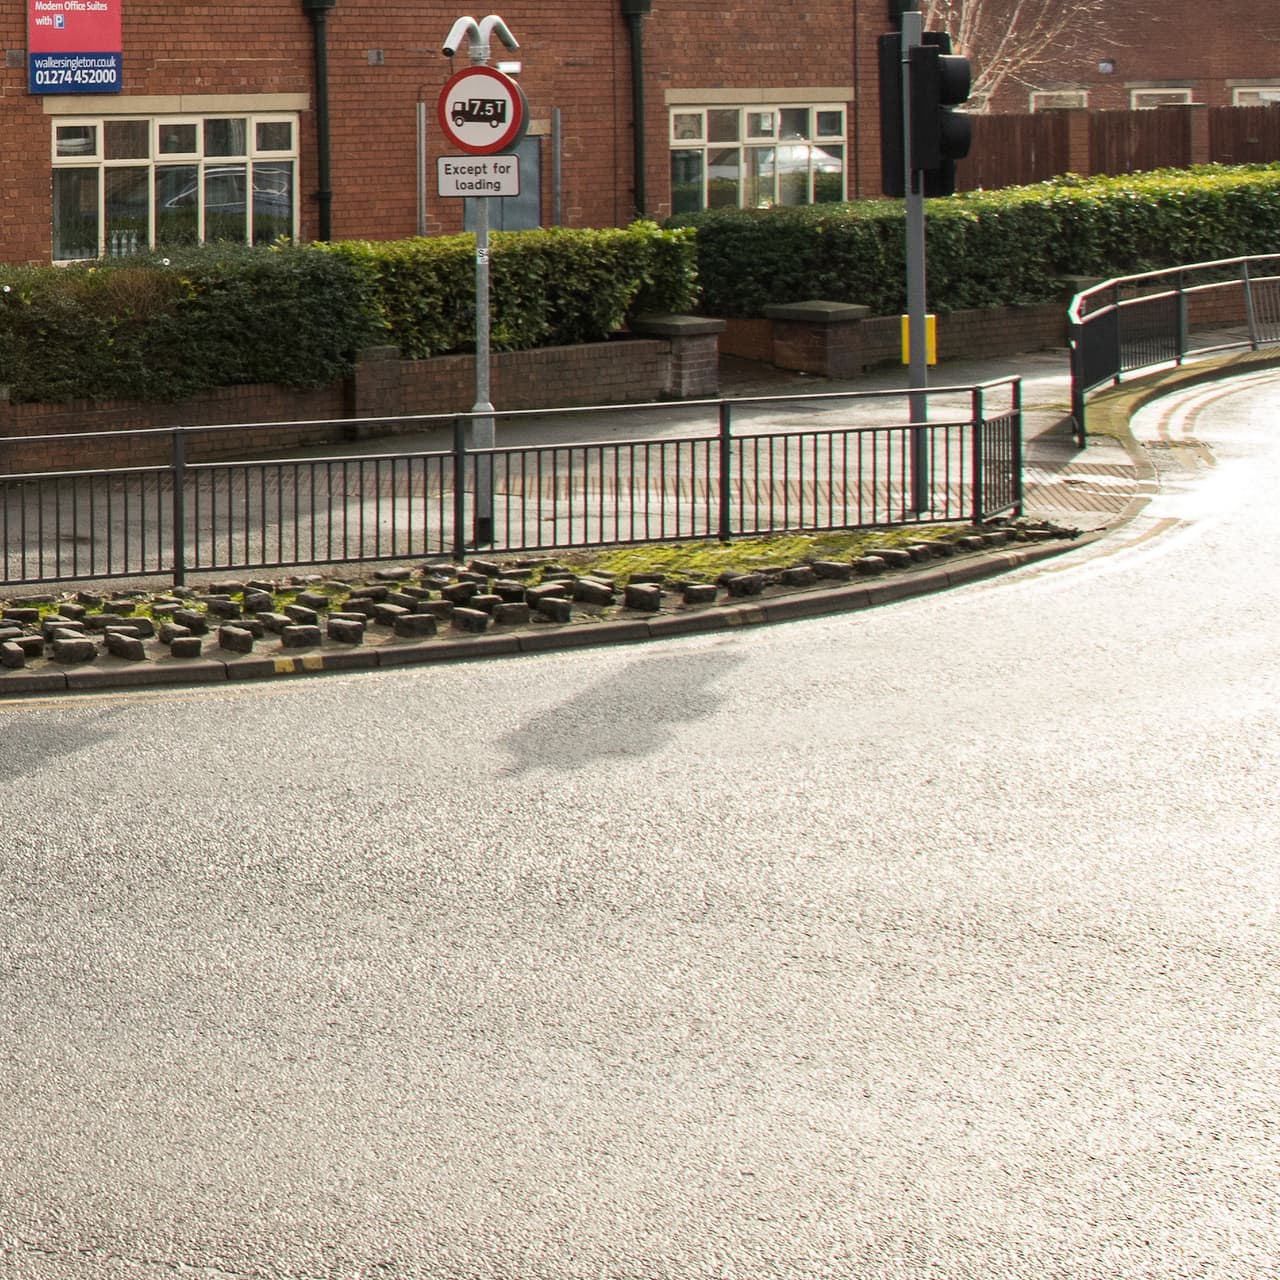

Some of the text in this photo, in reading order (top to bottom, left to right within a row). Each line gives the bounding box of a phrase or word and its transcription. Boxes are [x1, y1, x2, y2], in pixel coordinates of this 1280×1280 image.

[35, 0, 108, 11] Modern Office Suites
[35, 15, 63, 26] with P
[35, 56, 116, 71] walkersingleton.co.uk
[35, 69, 116, 84] 01274 452000
[471, 100, 504, 116] 7.5T
[444, 163, 511, 176] Except for
[456, 179, 501, 191] loading
